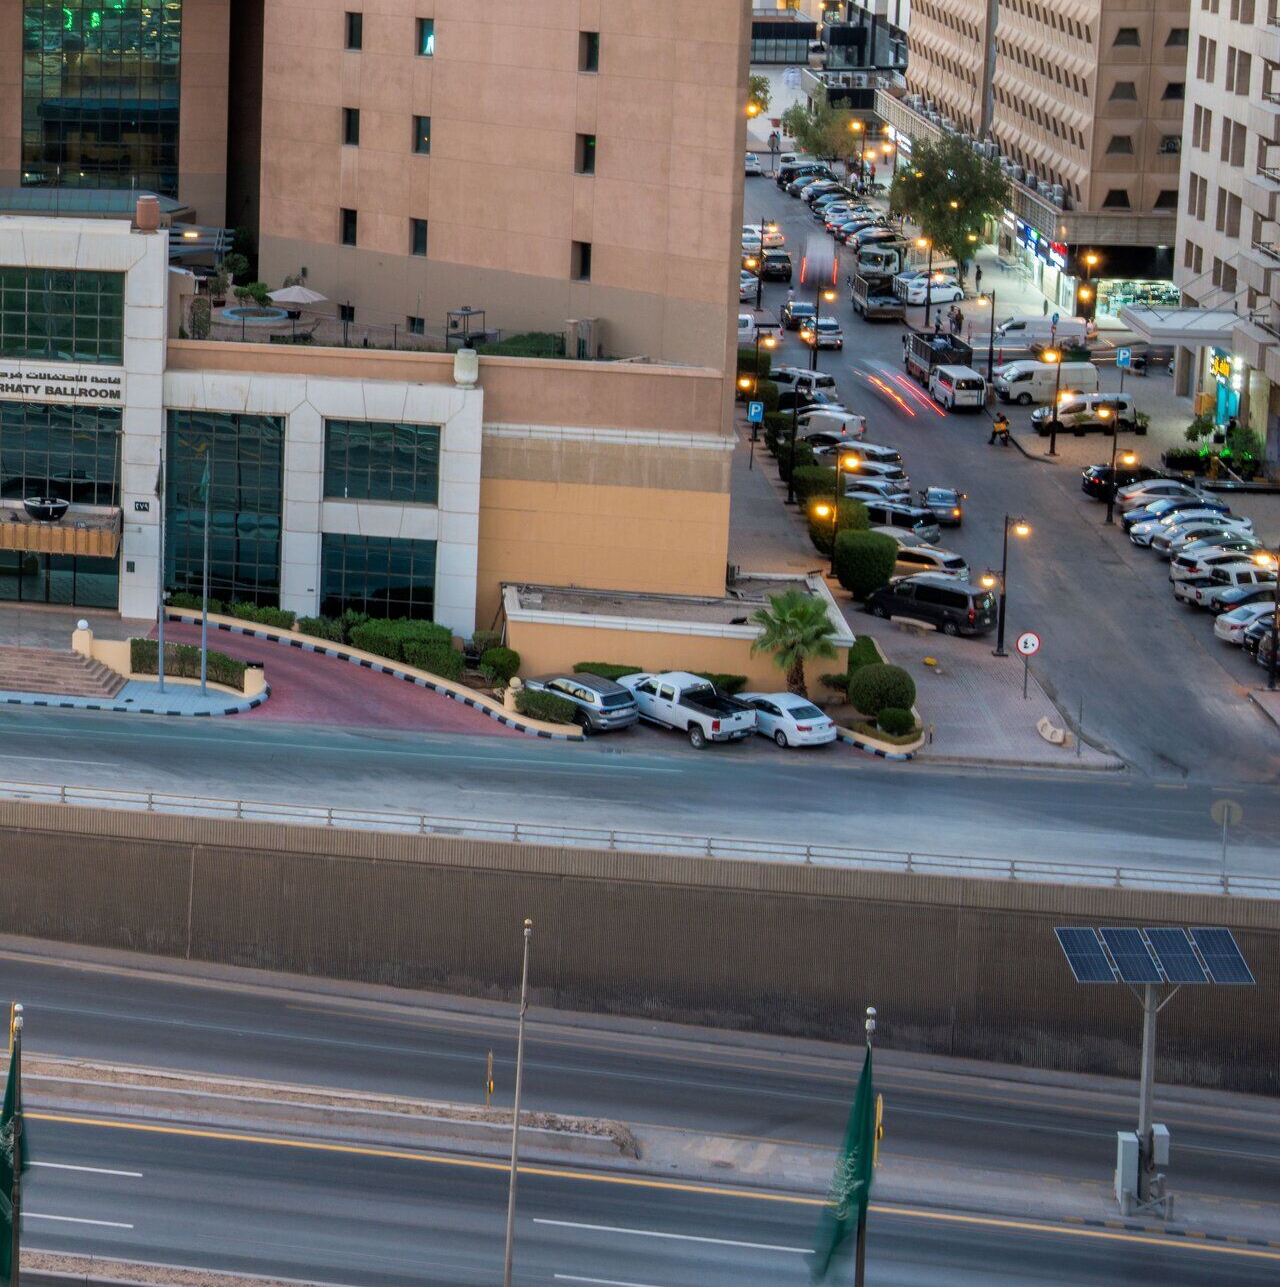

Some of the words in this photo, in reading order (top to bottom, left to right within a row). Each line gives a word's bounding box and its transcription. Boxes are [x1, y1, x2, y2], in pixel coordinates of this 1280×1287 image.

[1119, 349, 1130, 362] P
[26, 372, 87, 383] الاحتفالات
[91, 376, 120, 385] قاعة
[45, 385, 121, 400] BALLROOM
[751, 403, 761, 416] P
